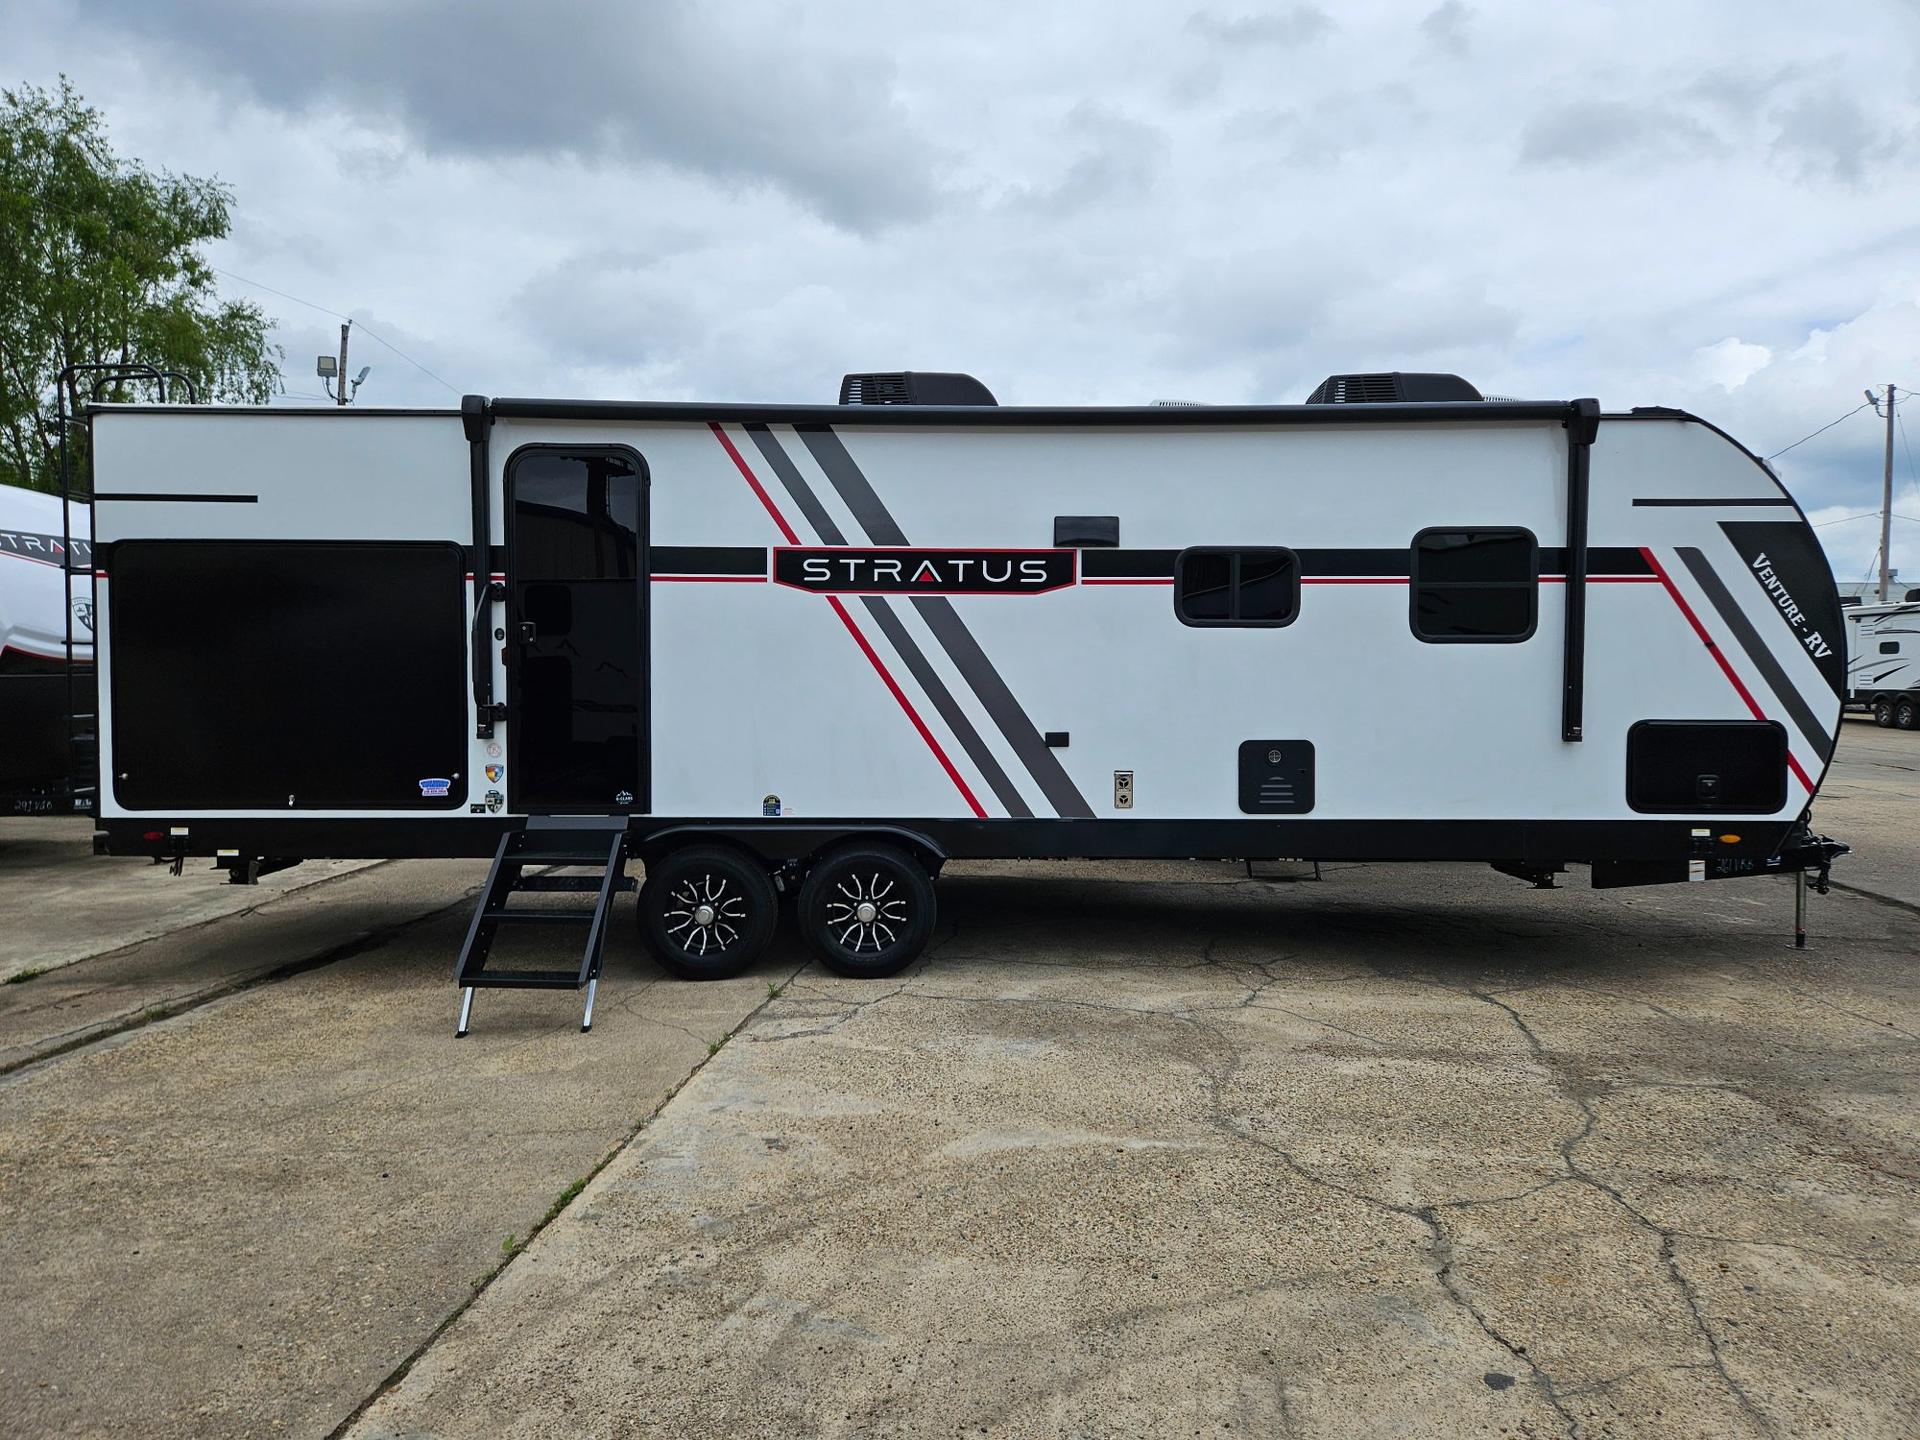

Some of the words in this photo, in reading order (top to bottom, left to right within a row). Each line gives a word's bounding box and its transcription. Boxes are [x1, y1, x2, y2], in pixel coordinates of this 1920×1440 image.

[0, 533, 91, 555] TRAT
[802, 558, 1048, 583] STRATUS
[1804, 631, 1833, 659] RV
